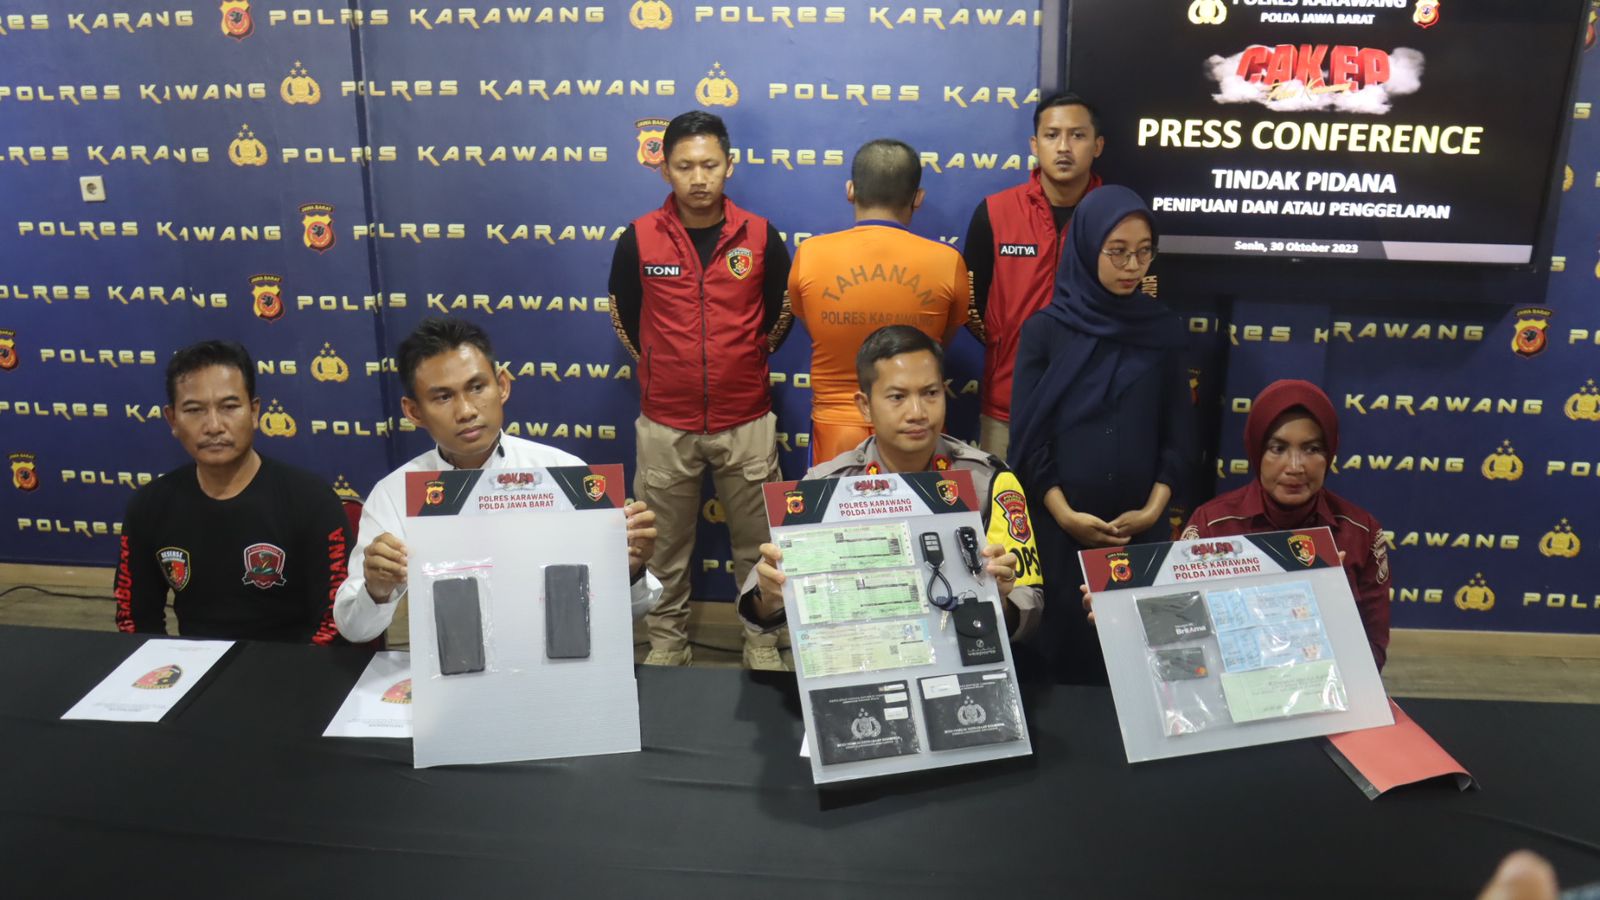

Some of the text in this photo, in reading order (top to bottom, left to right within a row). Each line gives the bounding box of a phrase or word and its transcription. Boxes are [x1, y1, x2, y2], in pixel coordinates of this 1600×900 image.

[410, 6, 605, 30] KARAWANG
[695, 6, 846, 28] POLRES
[1261, 12, 1376, 25] POLDA JAWA BARAT
[1236, 43, 1391, 91] CAKEP
[480, 79, 675, 101] KARAWANG
[769, 82, 920, 106] POLRES
[1137, 117, 1484, 156] PRESS CONFERENCE
[418, 145, 608, 167] KARAWANG
[1212, 168, 1397, 194] TINDAK PIDANA
[1152, 197, 1450, 219] PENIPUAN DAN ATAU PENGGELAPAN
[19, 220, 139, 241] POLRES
[1001, 245, 1036, 255] ADITYA
[1234, 240, 1358, 254] Senin, 30 Oktober 2023
[645, 266, 679, 275] TONI
[822, 264, 939, 308] TAHANAN
[427, 292, 609, 315] KARAWANG
[821, 311, 934, 327] POLRES KARAWANG
[41, 347, 157, 368] POLRES
[1345, 393, 1543, 416] KARAWANG
[478, 493, 554, 503] POLRES KARAWANG
[479, 500, 554, 510] POLDA JAWA BARAT
[838, 498, 912, 509] POLRES KARAWANG
[840, 505, 913, 516] POLDA JAWA BARAT
[18, 517, 122, 538] POLRES
[1009, 546, 1042, 579] OPS
[1173, 557, 1260, 572] POLRES KARAWANG
[1175, 565, 1261, 581] POLDA JAWA BARAT
[1175, 625, 1206, 636] BritAma
